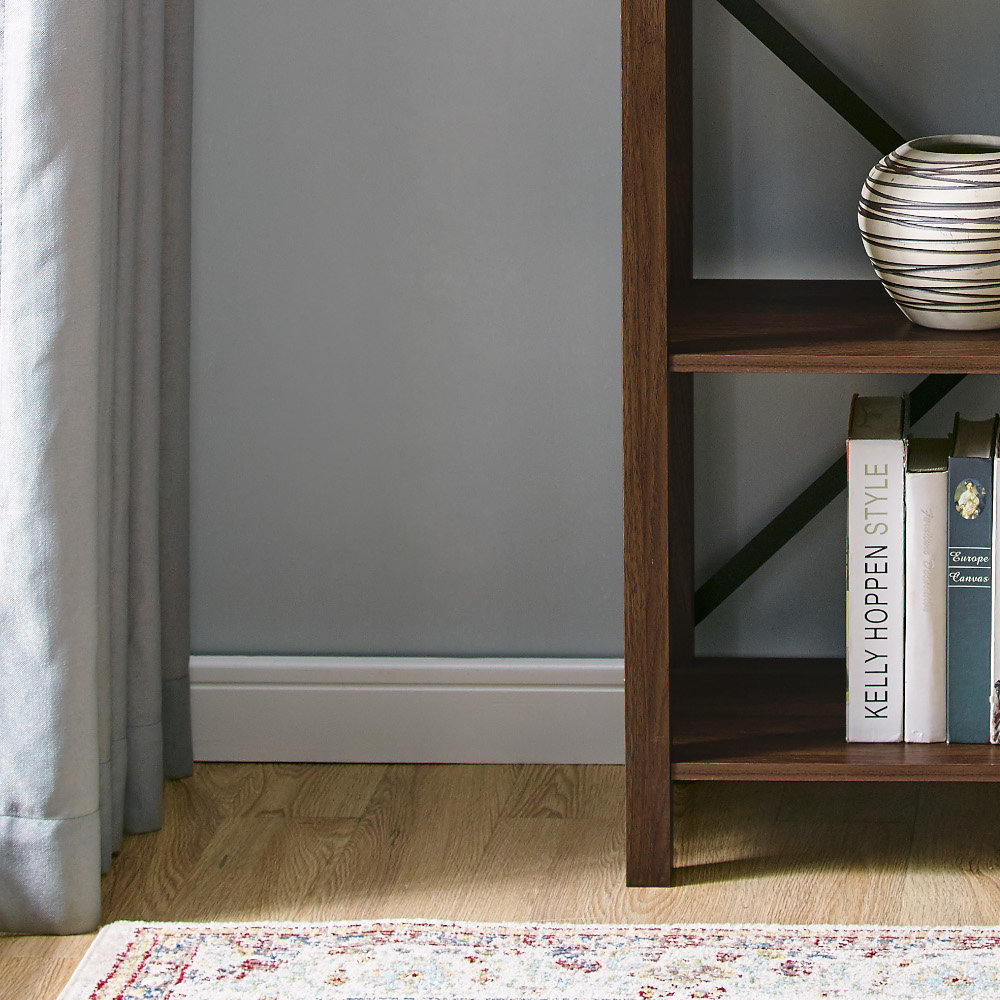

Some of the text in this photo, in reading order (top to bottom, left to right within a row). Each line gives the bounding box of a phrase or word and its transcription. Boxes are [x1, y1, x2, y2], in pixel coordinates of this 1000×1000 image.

[949, 551, 990, 565] Europe
[949, 572, 990, 584] Canvas
[864, 463, 888, 719] KELLY HOPPEN STYLE
